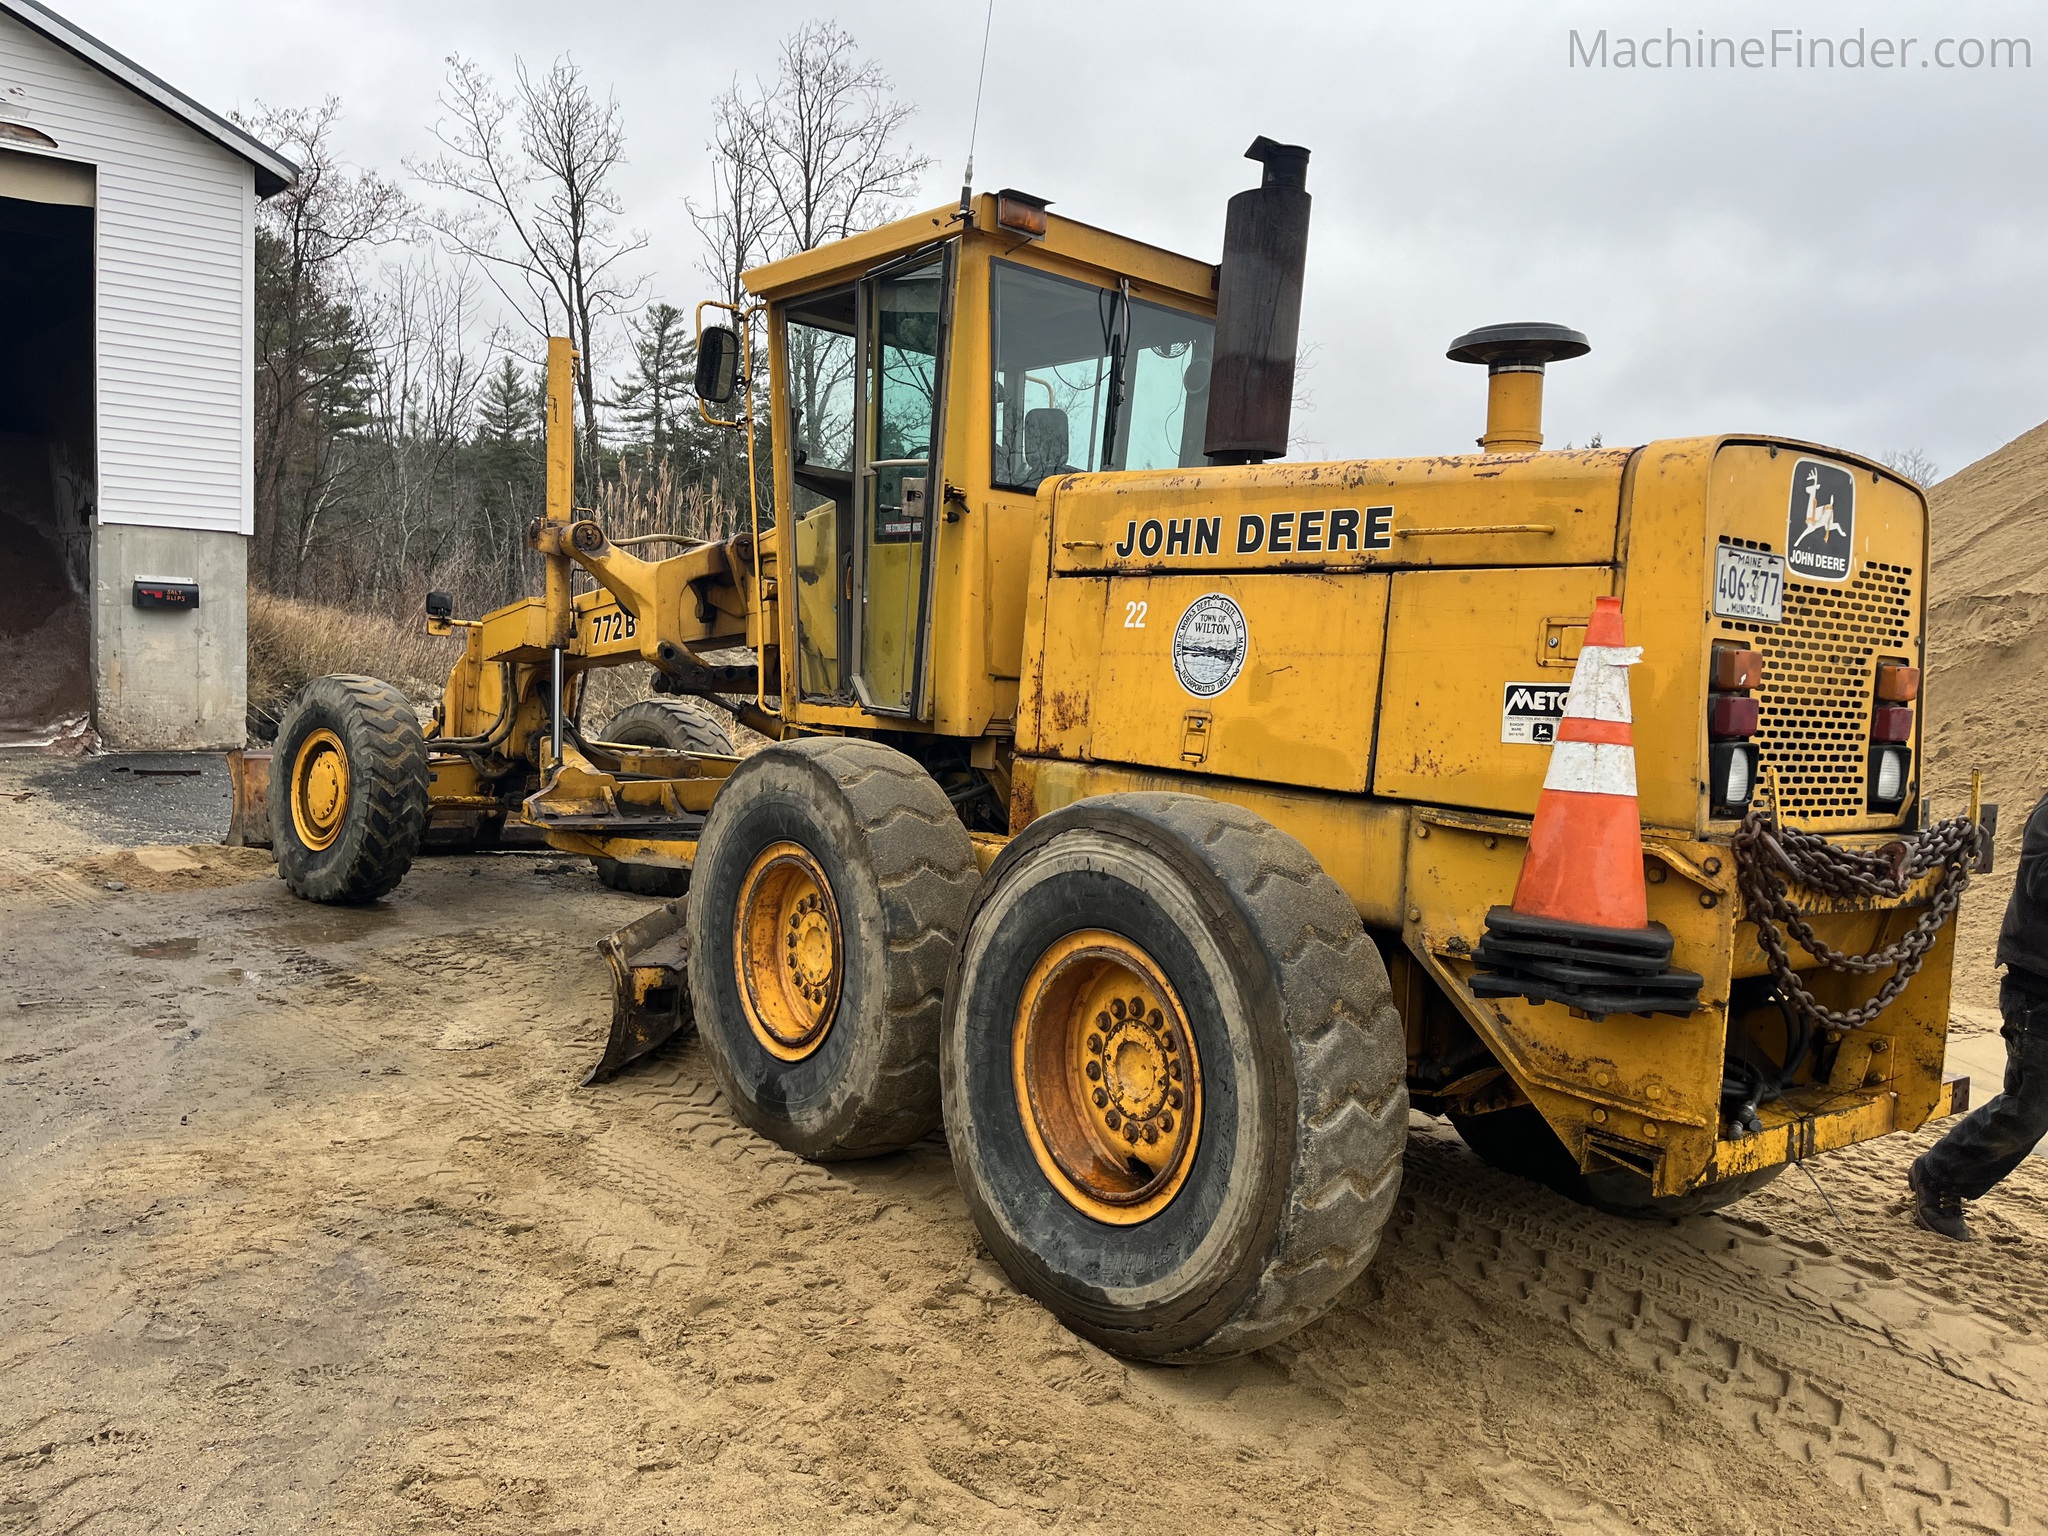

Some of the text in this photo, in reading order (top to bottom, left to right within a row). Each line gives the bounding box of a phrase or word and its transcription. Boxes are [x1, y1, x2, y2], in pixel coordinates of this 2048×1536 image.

[1115, 504, 1395, 559] JOHN DEERE
[1738, 554, 1763, 568] MAINE
[1790, 549, 1846, 571] JOHN DEERE
[1124, 601, 1148, 628] 22
[1180, 609, 1196, 631] WORKS
[1200, 614, 1227, 623] TOWN OF
[1731, 603, 1765, 617] MUNICIPAL
[593, 612, 637, 645] 772B
[1195, 621, 1231, 635] WILTON
[1220, 600, 1243, 662] STATE OF MAINE
[1180, 669, 1215, 692] INCORPORATED
